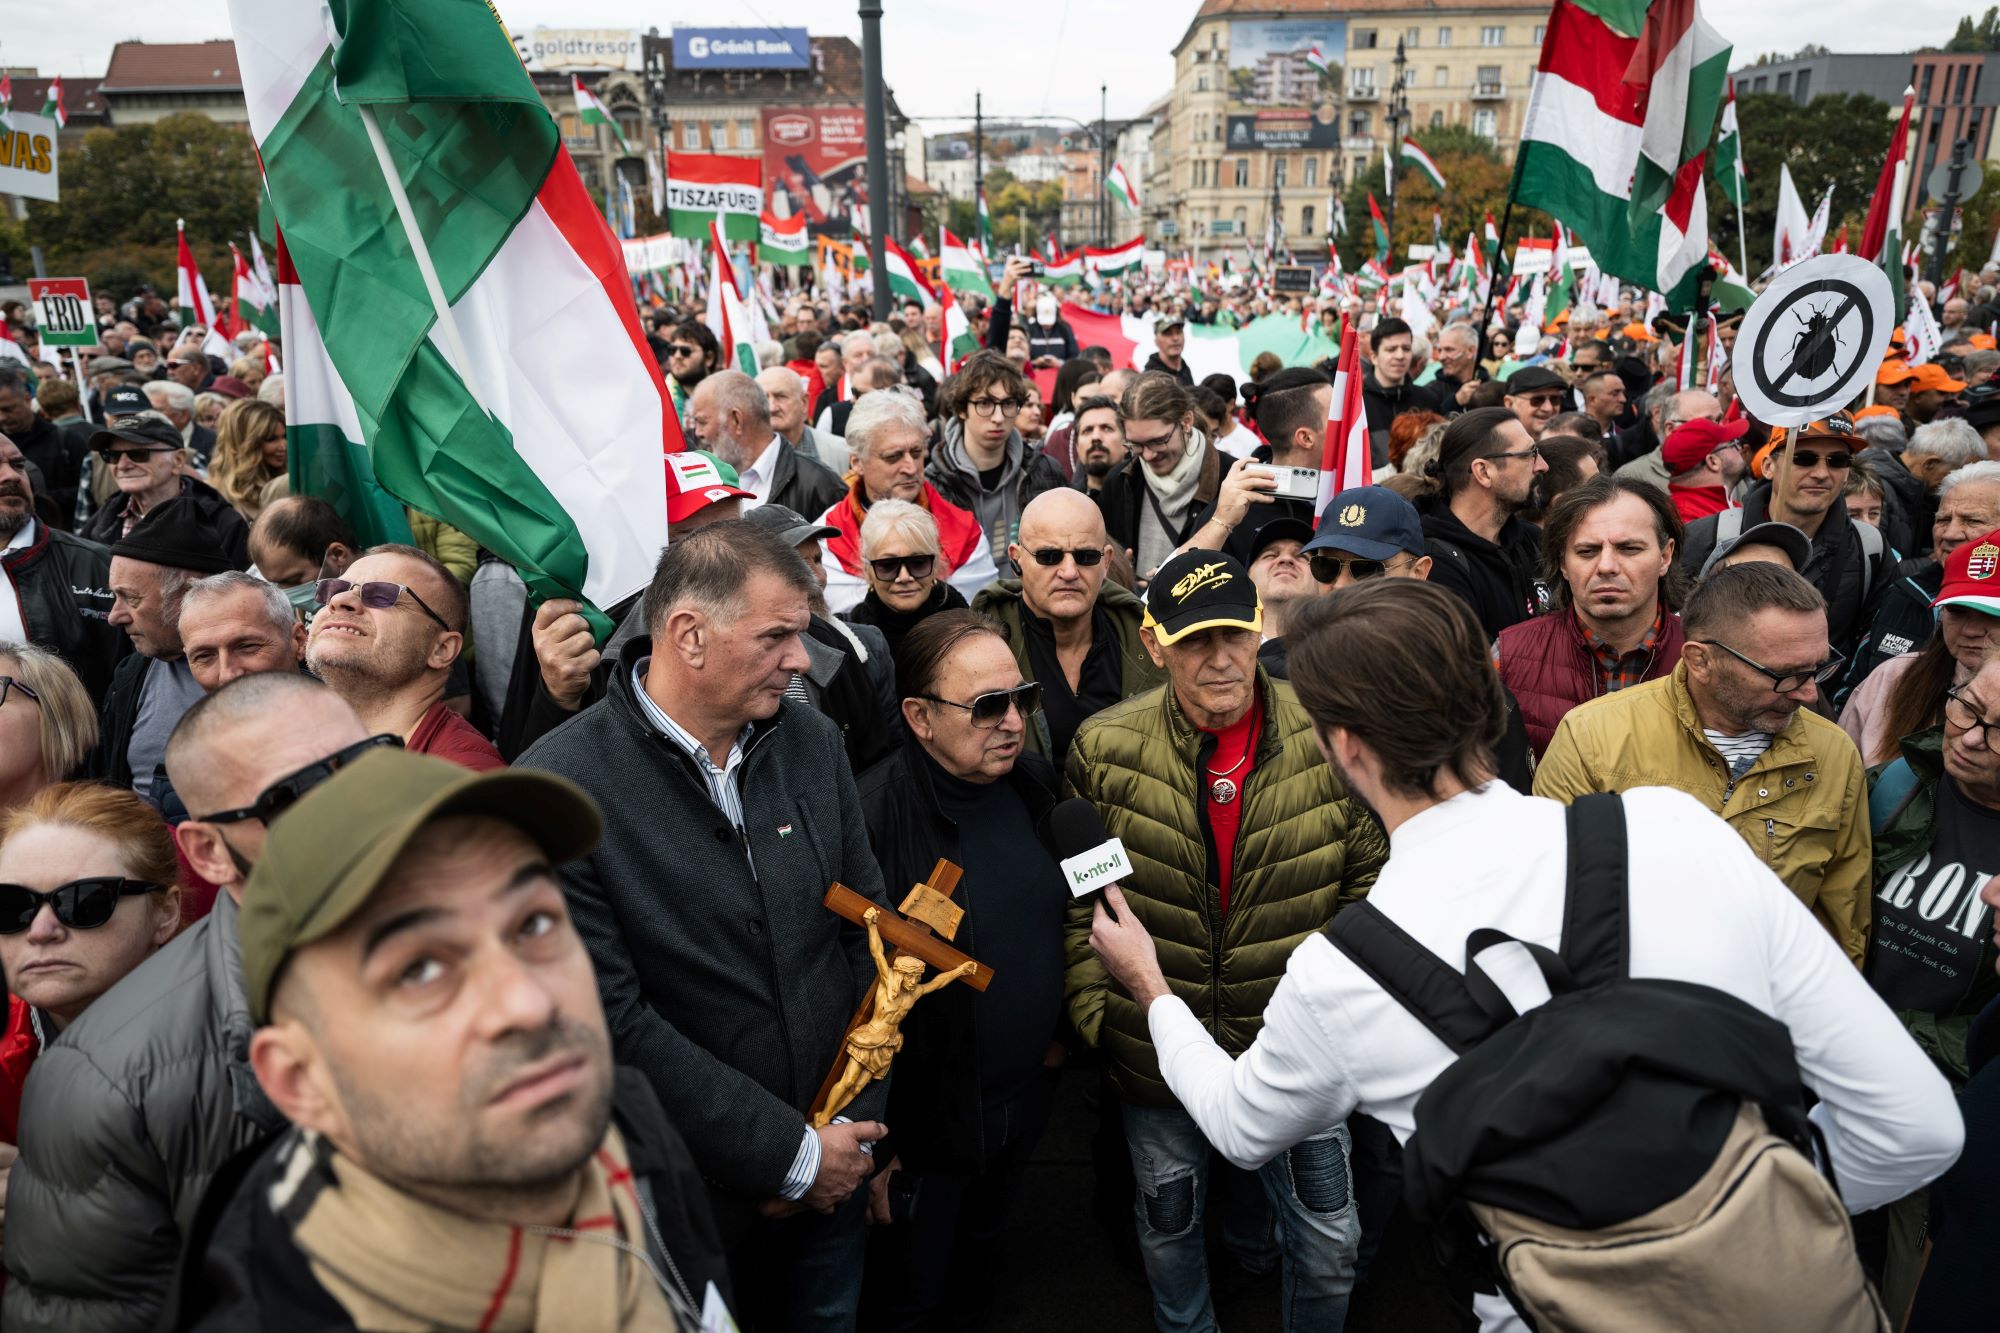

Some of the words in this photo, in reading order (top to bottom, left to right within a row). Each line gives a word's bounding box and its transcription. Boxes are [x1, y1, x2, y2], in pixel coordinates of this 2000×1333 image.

[534, 39, 637, 58] goldtresor
[756, 40, 793, 54] Bank
[40, 286, 84, 331] ÉRD
[1880, 639, 1909, 653] RACING
[1884, 632, 1914, 648] MARTINI
[1880, 915, 1895, 928] Spa
[1896, 922, 1908, 932] &
[1908, 928, 1936, 945] Health
[1937, 940, 1958, 955] Club
[1900, 945, 1920, 960] New
[1920, 954, 1939, 969] York
[1940, 963, 1958, 978] City
